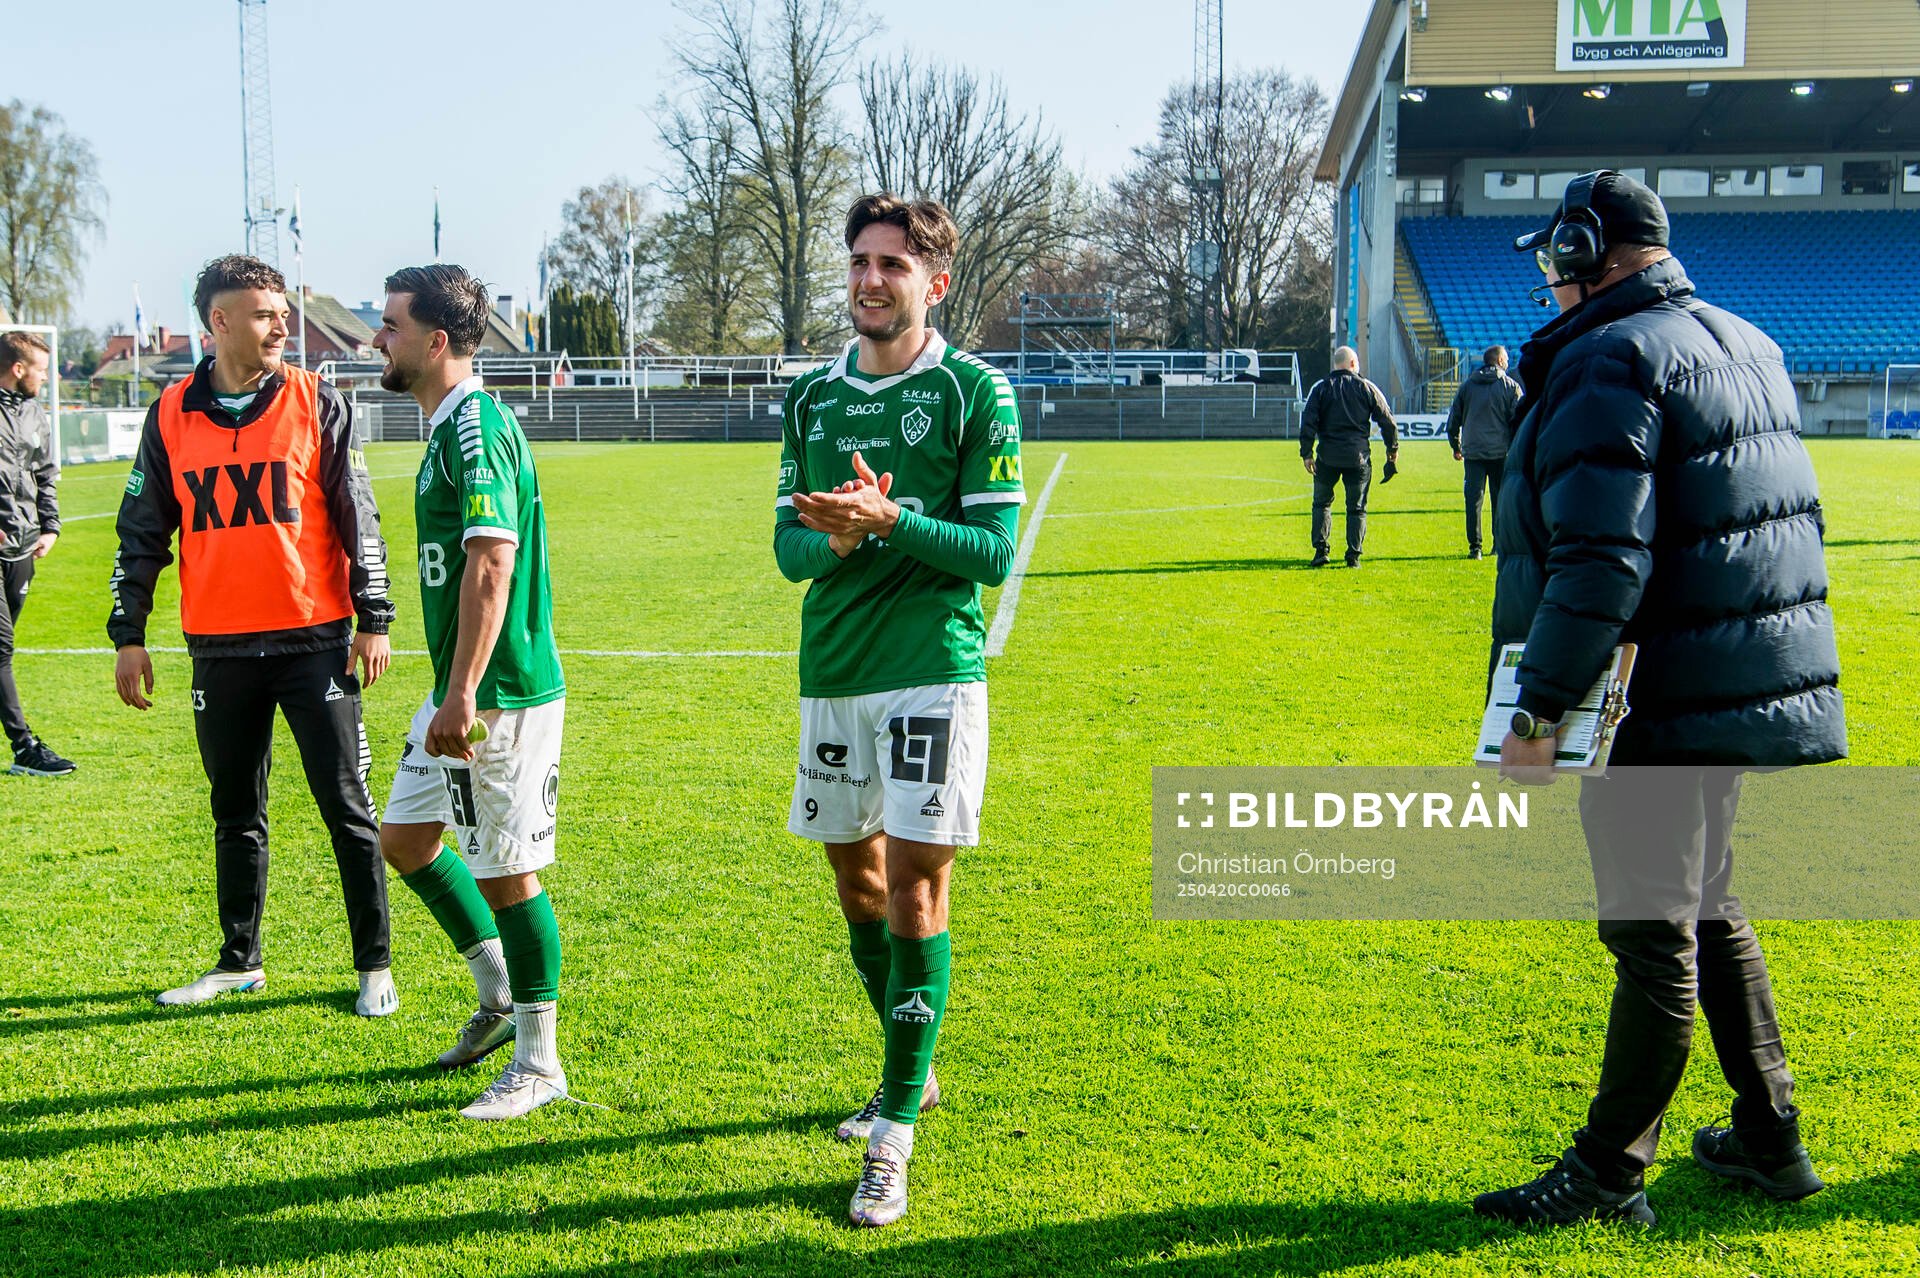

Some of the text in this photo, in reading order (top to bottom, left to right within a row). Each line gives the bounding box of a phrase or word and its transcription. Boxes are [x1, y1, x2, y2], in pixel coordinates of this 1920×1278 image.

[1575, 43, 1724, 60] Bygg och Anläggning
[808, 433, 825, 442] SELECT
[182, 461, 300, 533] XXL
[325, 691, 345, 702] SELECT
[805, 797, 818, 822] 9
[920, 808, 944, 817] SELECT
[892, 1011, 935, 1024] SELECT
